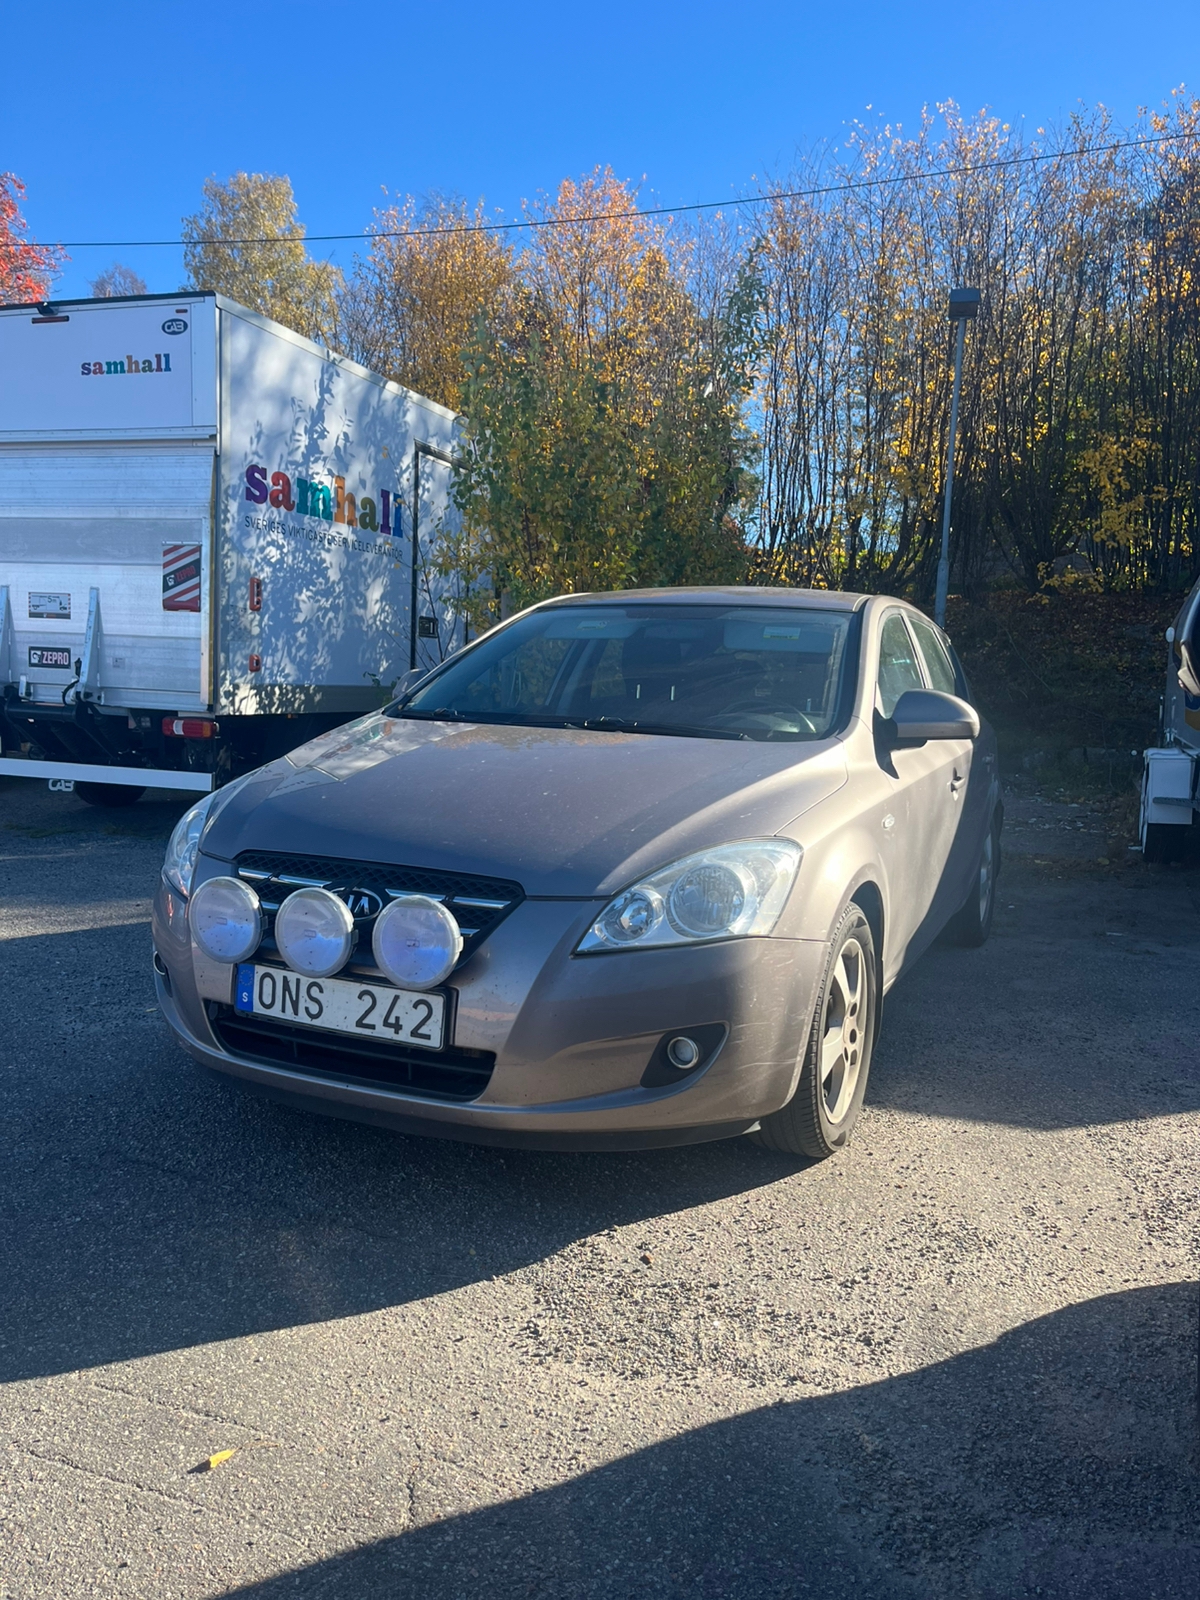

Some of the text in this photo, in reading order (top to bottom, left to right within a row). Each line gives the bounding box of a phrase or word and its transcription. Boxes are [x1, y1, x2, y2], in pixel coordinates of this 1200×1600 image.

[81, 353, 172, 376] samhall
[245, 464, 404, 538] samhall
[244, 515, 287, 535] SVERIGES
[42, 651, 69, 665] ZEPRO
[242, 992, 249, 1003] S
[258, 971, 433, 1041] ONS 242
